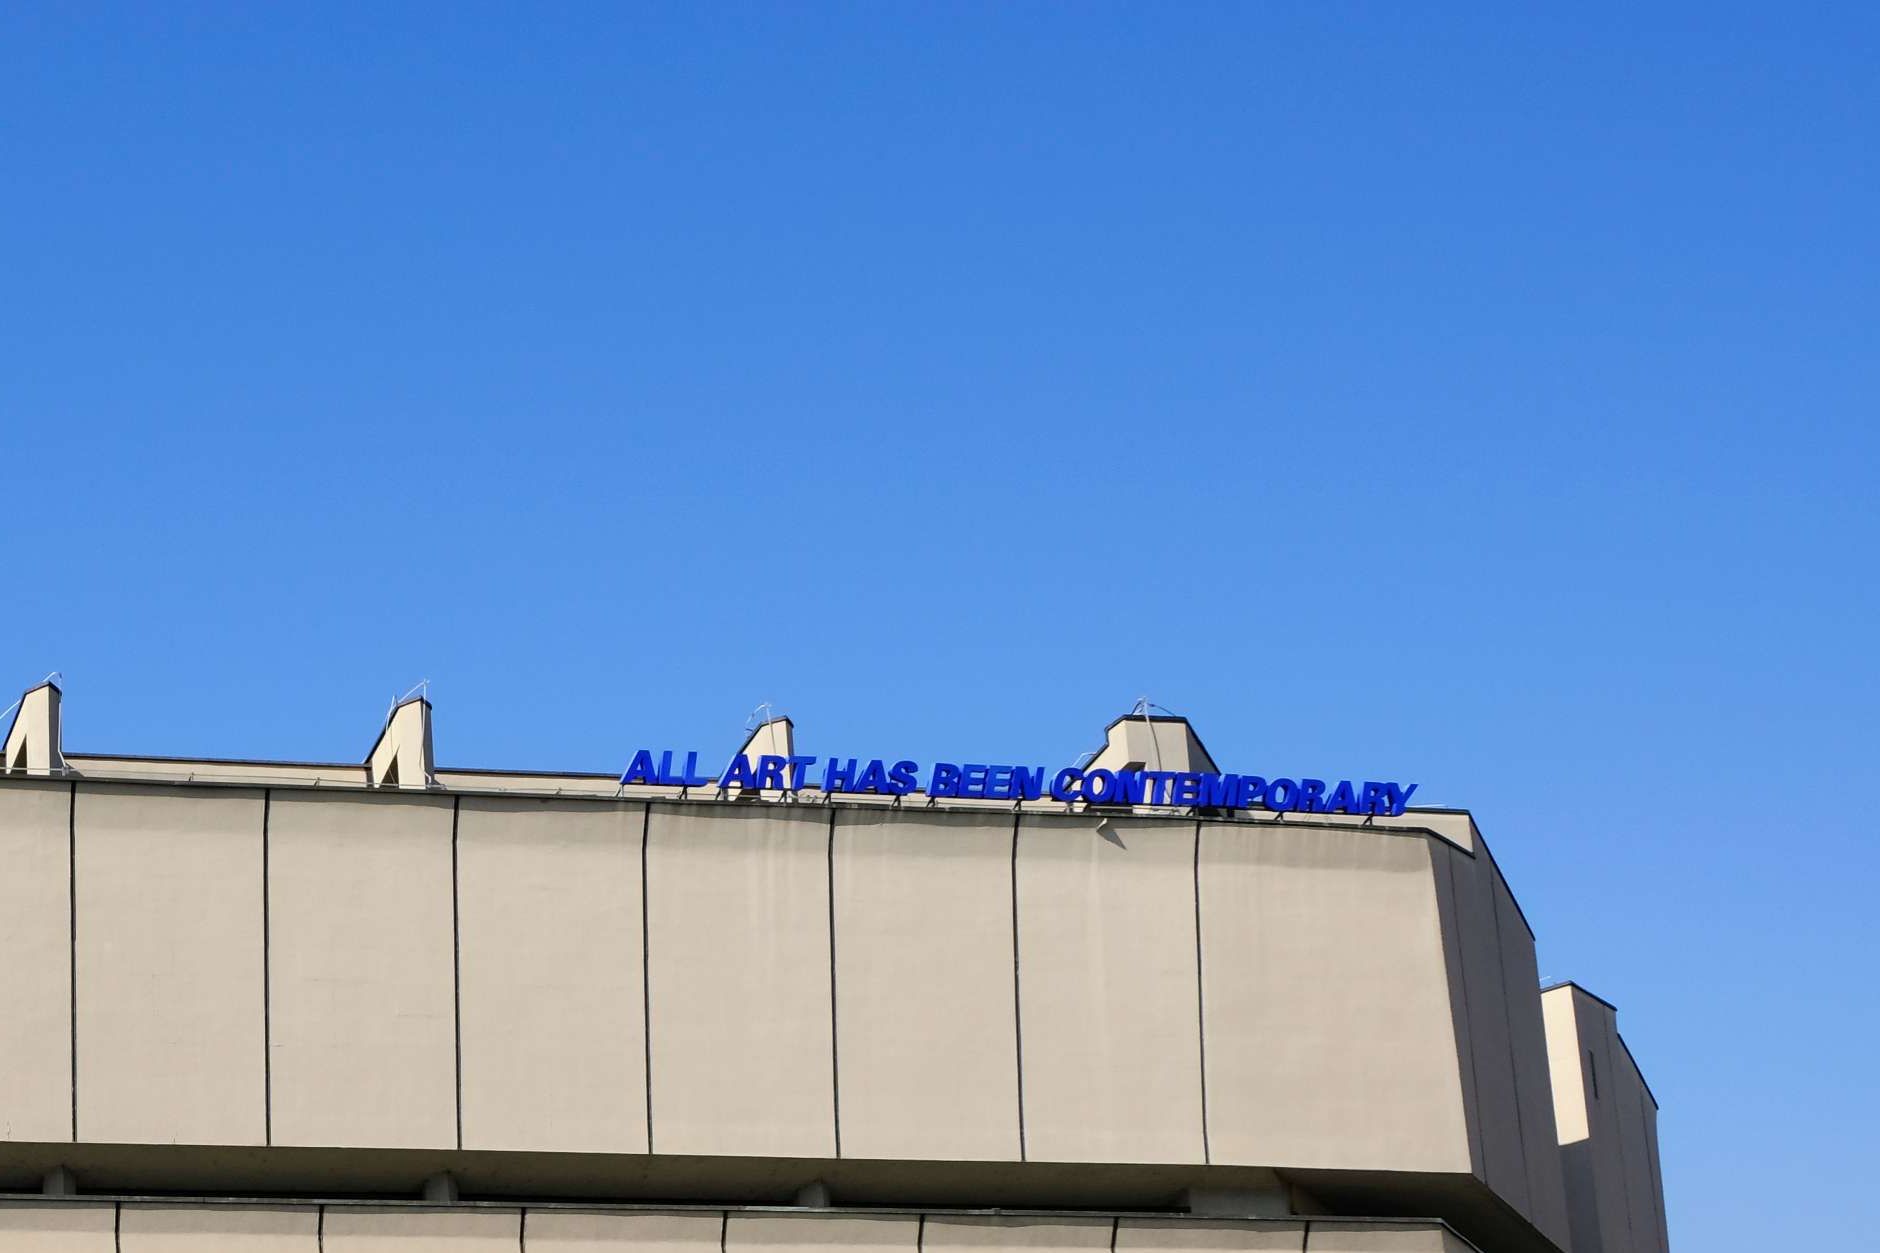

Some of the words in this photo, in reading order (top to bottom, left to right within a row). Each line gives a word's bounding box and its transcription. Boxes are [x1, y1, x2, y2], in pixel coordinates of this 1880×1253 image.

[620, 750, 707, 787] ALL
[717, 753, 816, 791] ART
[821, 757, 918, 795] HAS
[926, 763, 1045, 799] BEEN
[1050, 767, 1418, 817] CONTEMPORARY
